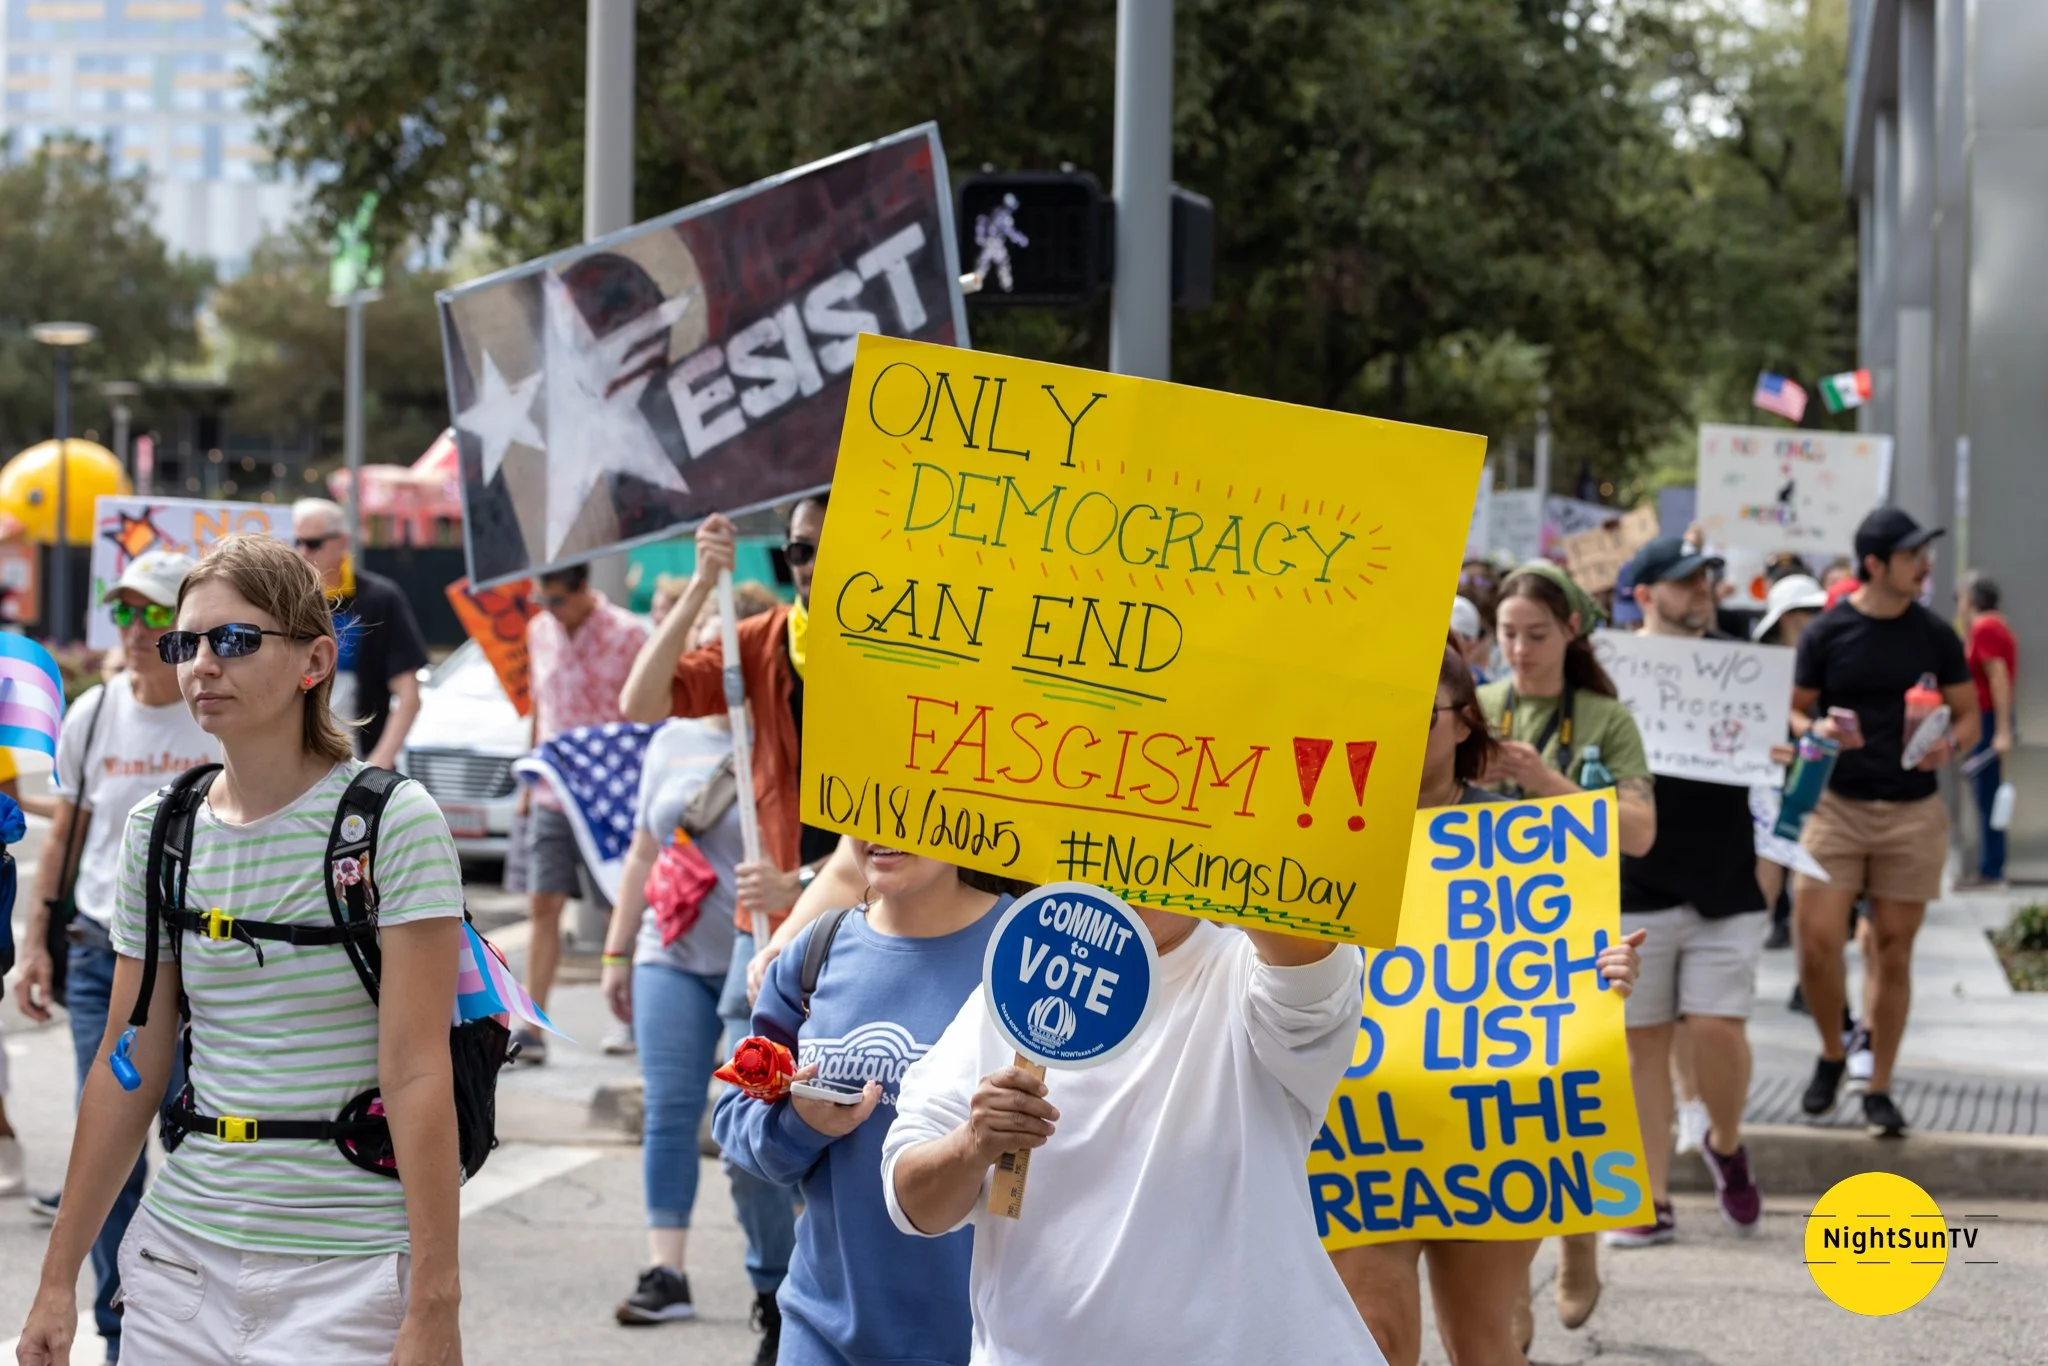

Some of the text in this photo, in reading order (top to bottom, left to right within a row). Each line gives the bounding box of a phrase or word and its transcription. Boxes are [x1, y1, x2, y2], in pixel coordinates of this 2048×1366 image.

[869, 362, 1107, 467] ONLY
[904, 461, 1355, 583] DEMOCRACY
[836, 571, 1183, 673] CAN END
[1656, 680, 1768, 723] Process
[819, 774, 1021, 867] 10/18/2025
[1429, 798, 1607, 871] SIGN
[1057, 829, 1356, 920] #NoKingsDay
[1448, 873, 1571, 940] BIG
[1039, 898, 1133, 956] COMMIT
[1070, 941, 1089, 959] to
[1019, 935, 1120, 1017] VOTE
[1001, 1002, 1010, 1021] Texas
[1009, 1019, 1020, 1033] NOW
[1017, 1030, 1041, 1050] Education
[1042, 1045, 1057, 1056] Fund
[1060, 1042, 1104, 1058] NOWTexas.com
[1027, 995, 1077, 1041] NOW
[1343, 1002, 1575, 1079] O LIST
[1450, 1070, 1606, 1152] THE
[1308, 1150, 1642, 1238] REASONS
